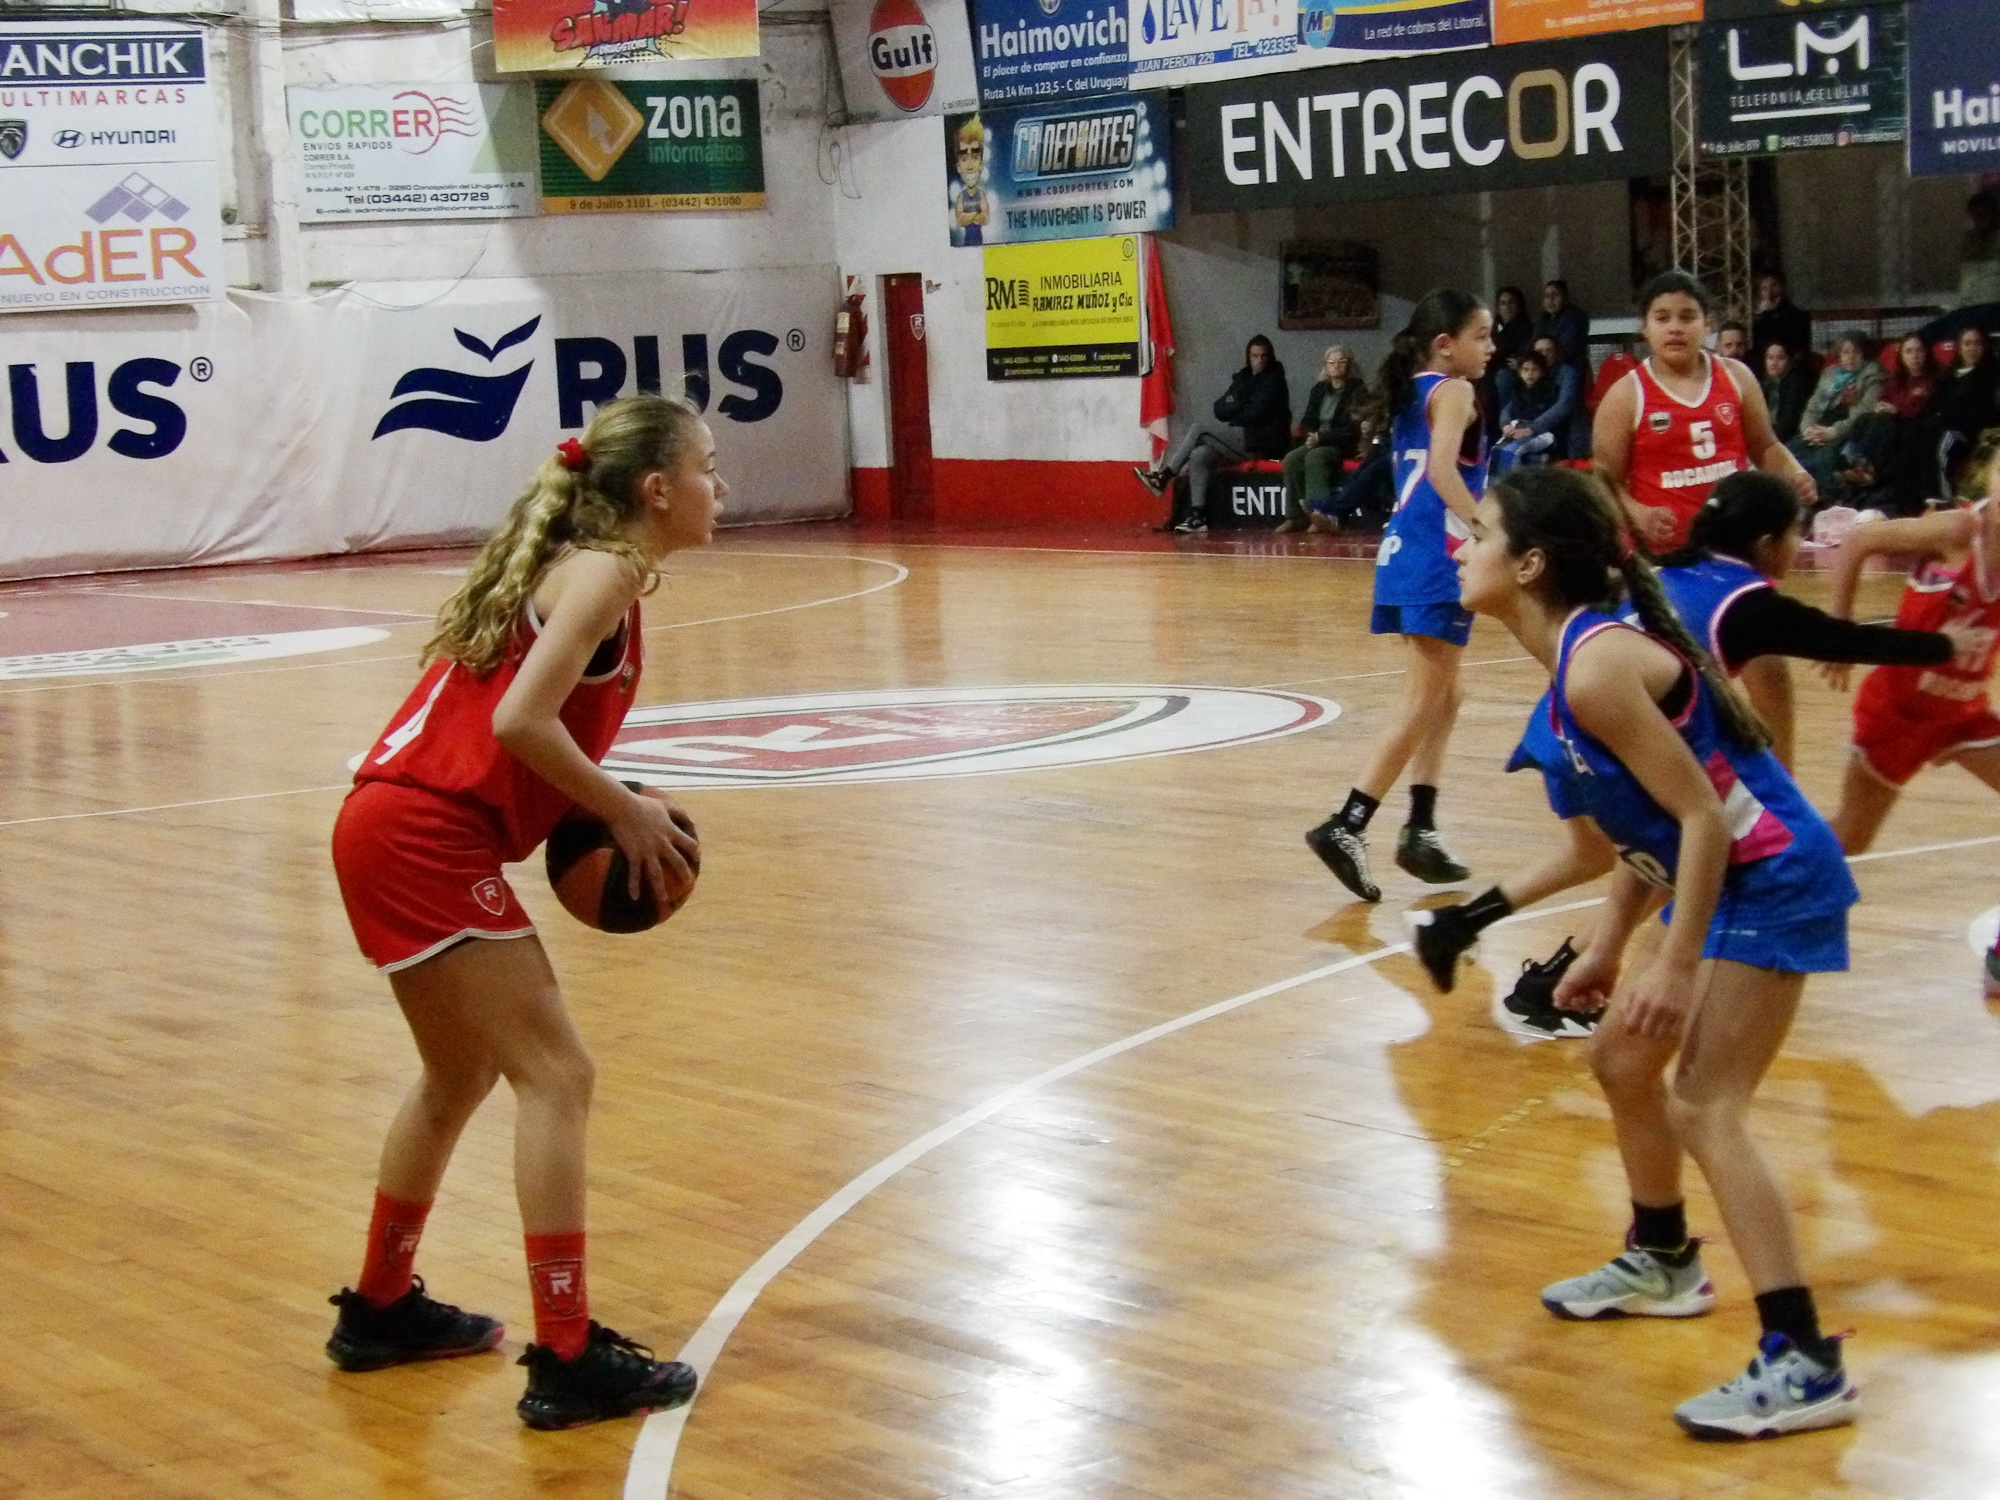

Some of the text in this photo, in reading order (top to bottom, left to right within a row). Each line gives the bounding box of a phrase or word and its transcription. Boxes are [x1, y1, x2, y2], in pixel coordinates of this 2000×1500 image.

[981, 7, 1127, 58] Haimovich
[1364, 28, 1375, 40] La
[1377, 25, 1392, 38] red
[1394, 23, 1405, 36] de
[1407, 20, 1435, 35] cobros
[1438, 18, 1452, 32] del
[872, 33, 932, 71] Gulf
[1256, 36, 1298, 55] 423353
[1727, 14, 1870, 80] LM
[2, 42, 188, 76] ANCHIK
[983, 53, 1128, 79] El placer de comprar en confianza
[1135, 52, 1215, 73] JUAN PERON 229
[2, 88, 186, 107] ULTIMARCAS
[984, 88, 1004, 100] Ruta
[1006, 85, 1017, 97] 14
[1018, 84, 1033, 96] Km
[1035, 81, 1059, 95] 123,5
[1067, 79, 1073, 91] C
[1075, 77, 1088, 90] del
[1091, 76, 1128, 90] Uruguay
[300, 109, 435, 139] CORRER
[646, 95, 742, 139] zona
[1220, 62, 1624, 186] ENTRECOR
[91, 129, 176, 145] HYUNDAI
[303, 141, 393, 151] ENVIOS RAPIDOS
[303, 153, 336, 162] CORRER
[345, 191, 490, 204] Tel (03442) 430729
[579, 198, 595, 209] de
[596, 198, 624, 209] Julio
[1006, 200, 1147, 229] THE MOVEMENT IS POWER
[0, 227, 207, 285] AdER
[1040, 271, 1123, 290] INMOBILIARIA
[60, 290, 81, 301] EN
[985, 277, 1018, 310] RM
[1032, 295, 1074, 312] RAMIREZ
[1077, 290, 1110, 309] MUÑOZ
[0, 358, 187, 463] US
[1690, 420, 1716, 460] 5
